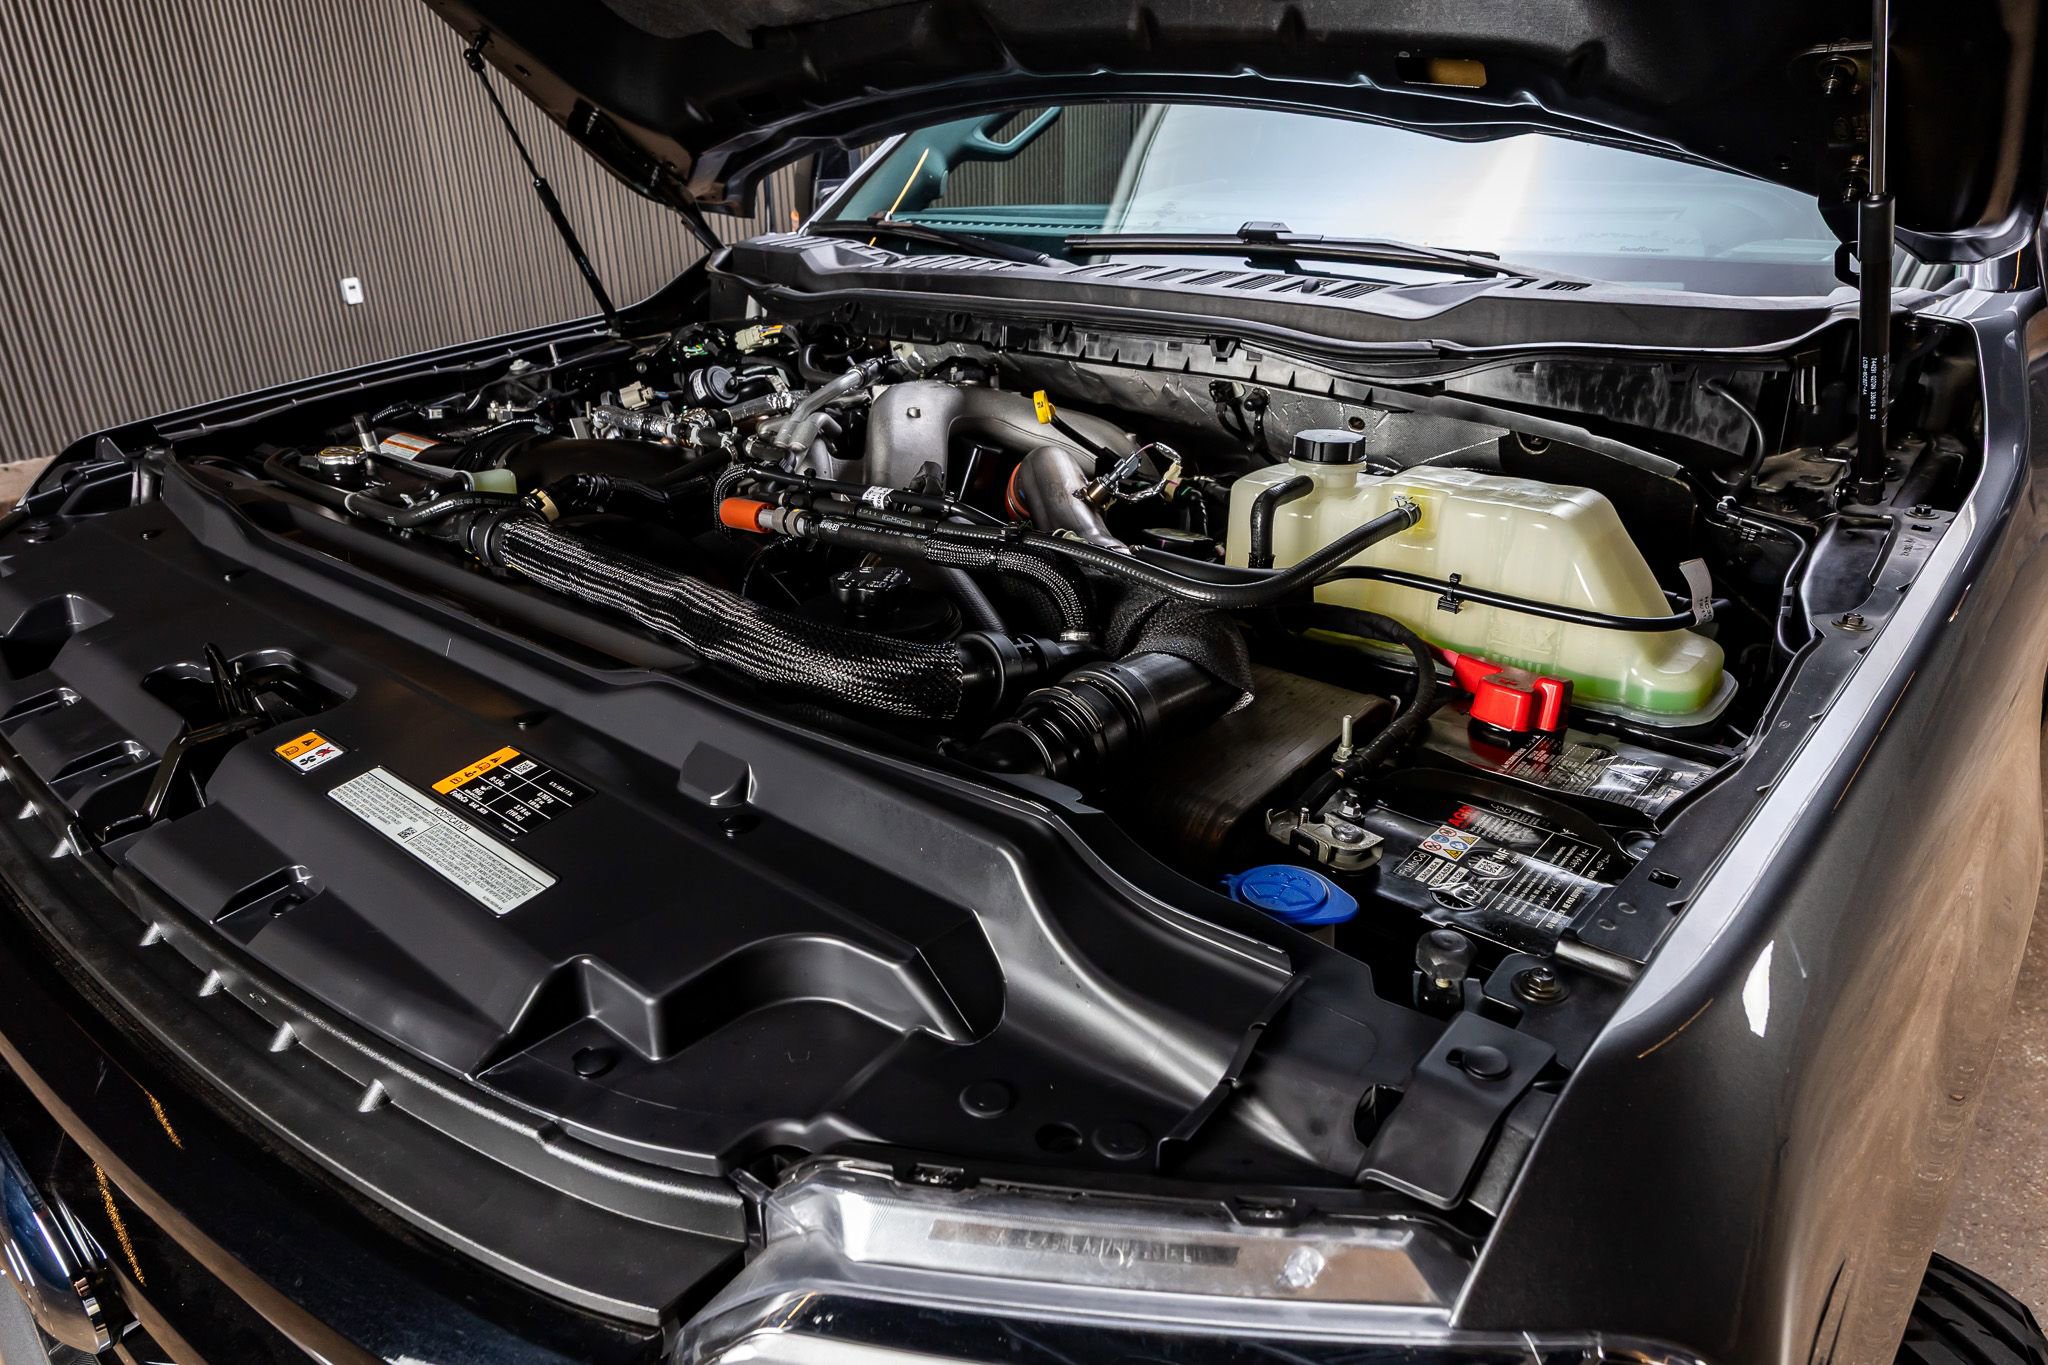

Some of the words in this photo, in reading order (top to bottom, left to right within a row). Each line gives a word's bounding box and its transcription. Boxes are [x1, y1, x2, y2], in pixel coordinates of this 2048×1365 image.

[431, 807, 472, 832] MODIFICATION
[1447, 805, 1475, 827] AGM
[1398, 852, 1427, 876] FoMoCo
